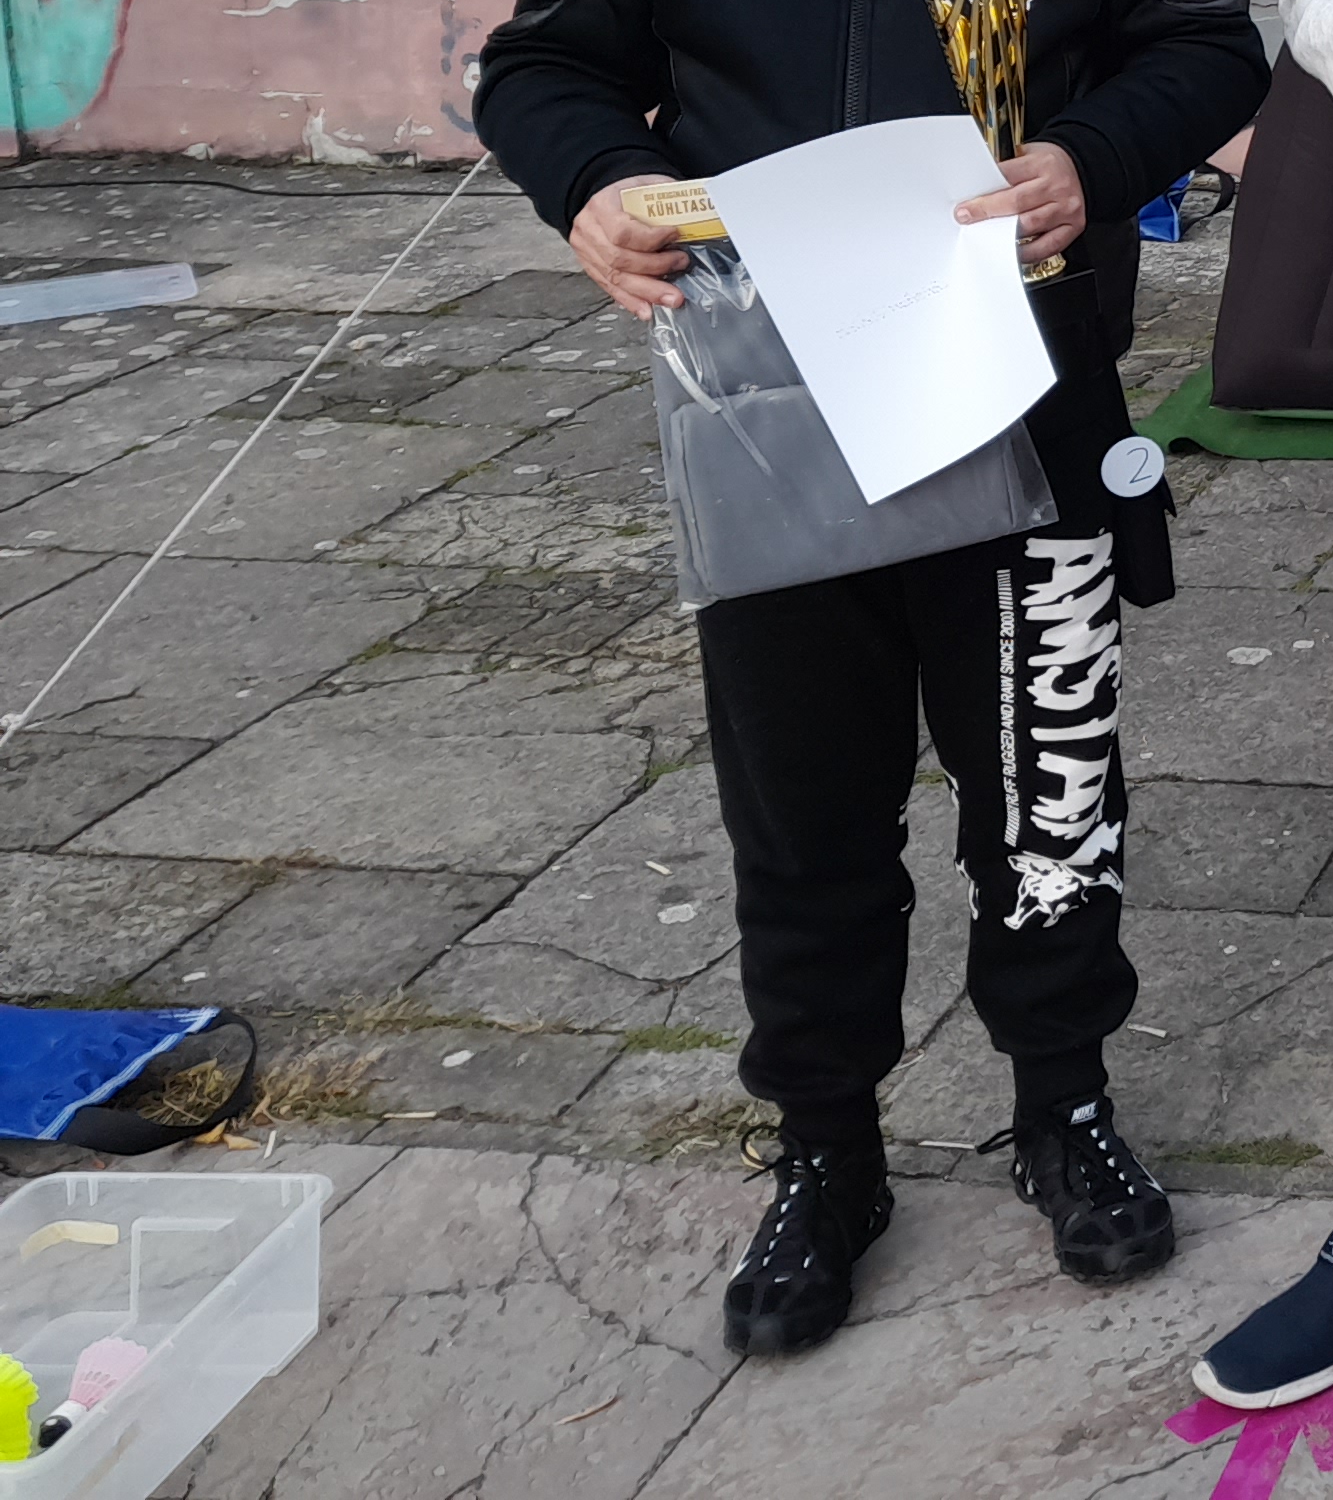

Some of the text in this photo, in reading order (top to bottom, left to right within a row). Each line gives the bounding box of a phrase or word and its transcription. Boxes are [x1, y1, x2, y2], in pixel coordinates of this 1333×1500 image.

[1126, 447, 1152, 485] 2
[1000, 639, 1015, 674] SINCE
[1000, 675, 1015, 702] RAW
[1000, 702, 1015, 729] AND
[1000, 731, 1017, 777] RUGGED
